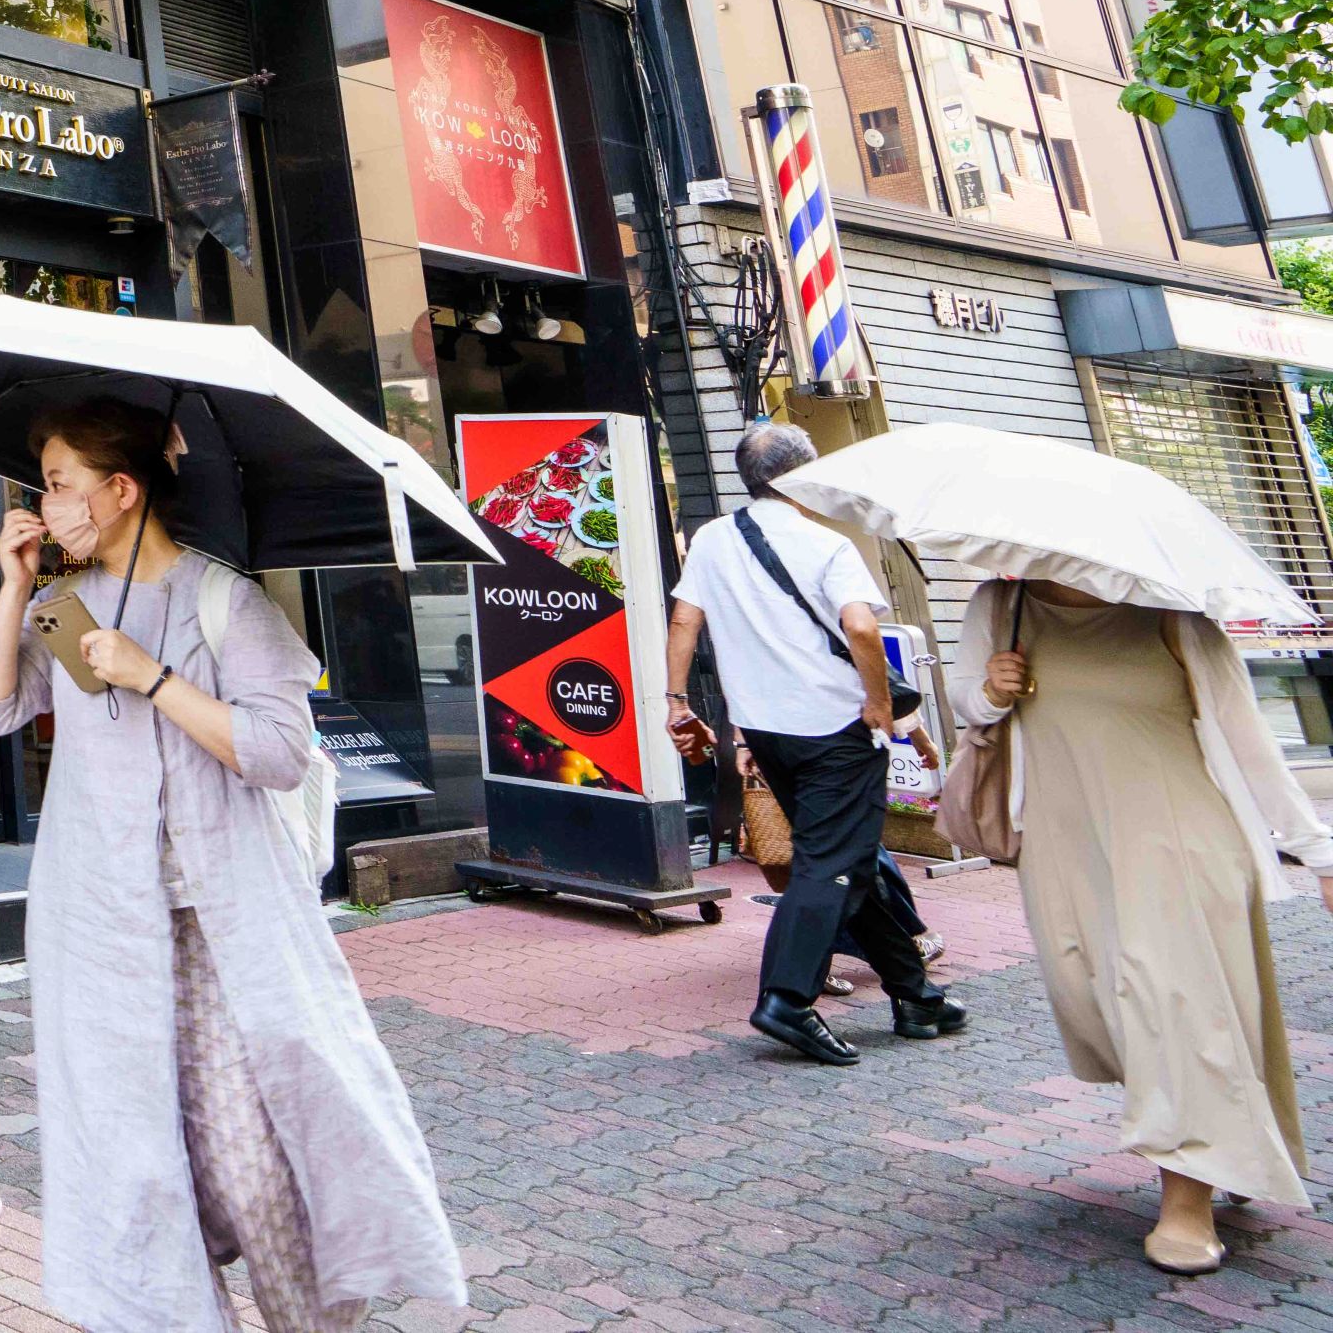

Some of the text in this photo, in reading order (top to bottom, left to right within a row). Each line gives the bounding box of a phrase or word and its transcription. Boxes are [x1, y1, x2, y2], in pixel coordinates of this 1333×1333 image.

[29, 81, 77, 104] SALON
[454, 101, 488, 117] KONG
[418, 106, 538, 155] KOW LOON
[165, 148, 190, 160] Esthe
[191, 145, 205, 155] Pro
[484, 587, 598, 612] KOWLOON
[519, 609, 564, 623] クーロン
[556, 680, 615, 704] CAFE
[565, 702, 608, 718] DINING
[337, 750, 401, 771] Supplements
